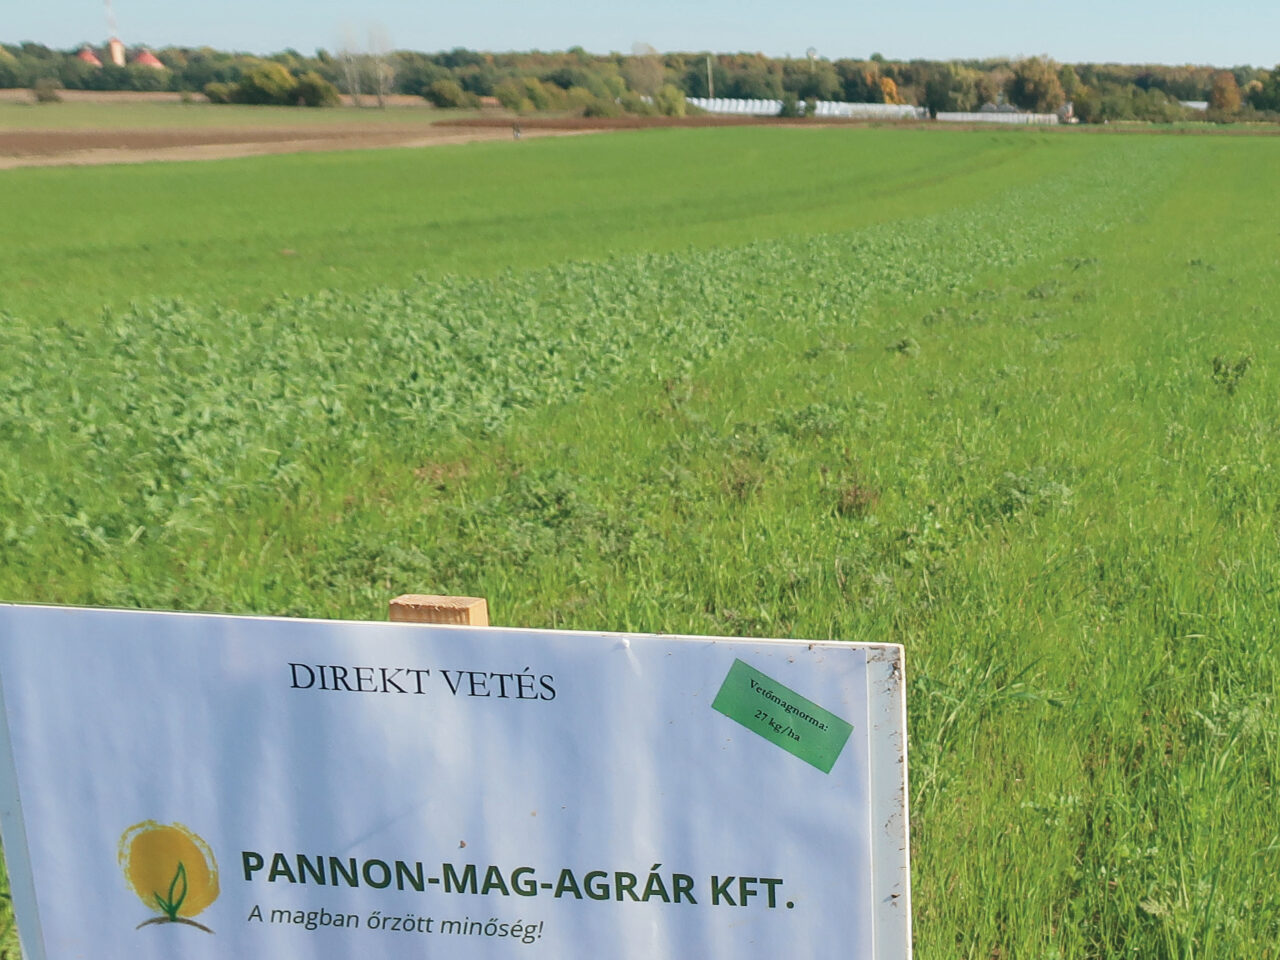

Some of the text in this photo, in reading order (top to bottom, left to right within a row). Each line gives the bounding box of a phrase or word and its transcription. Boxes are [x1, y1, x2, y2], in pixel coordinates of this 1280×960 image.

[288, 662, 557, 700] DIREKT VETÉS
[749, 678, 829, 732] Vetőmagnorma:
[754, 709, 801, 742] 27 kg/ha
[241, 851, 795, 910] PANNON-MAG-AGRÁR KFT.
[247, 904, 544, 944] A magban őrzött minőség!
